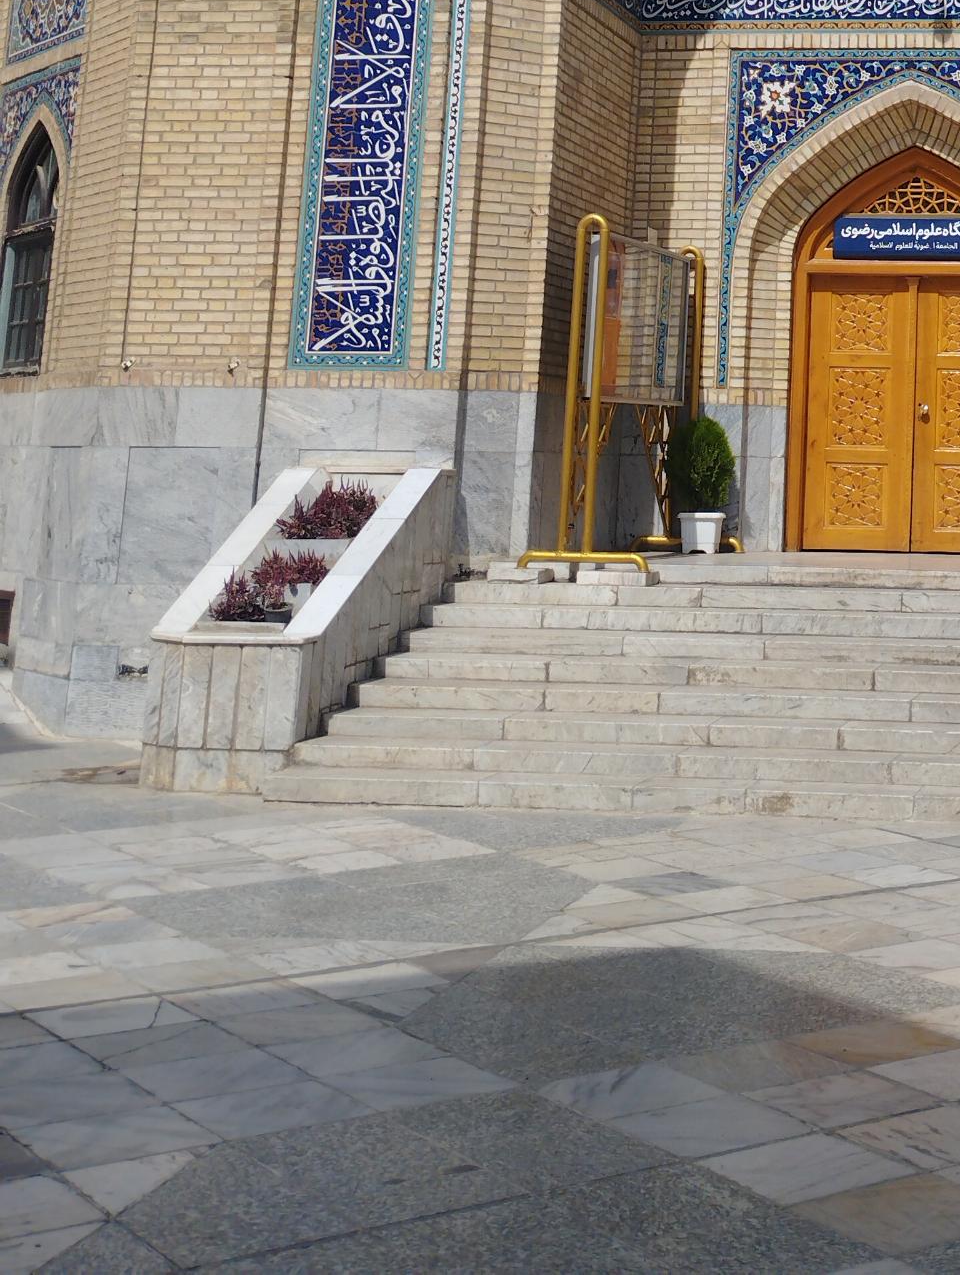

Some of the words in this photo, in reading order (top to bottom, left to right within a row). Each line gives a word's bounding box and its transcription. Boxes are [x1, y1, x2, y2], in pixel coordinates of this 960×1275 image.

[841, 223, 875, 239] رضوی
[875, 223, 916, 239] اسلامی
[915, 223, 943, 240] علوم
